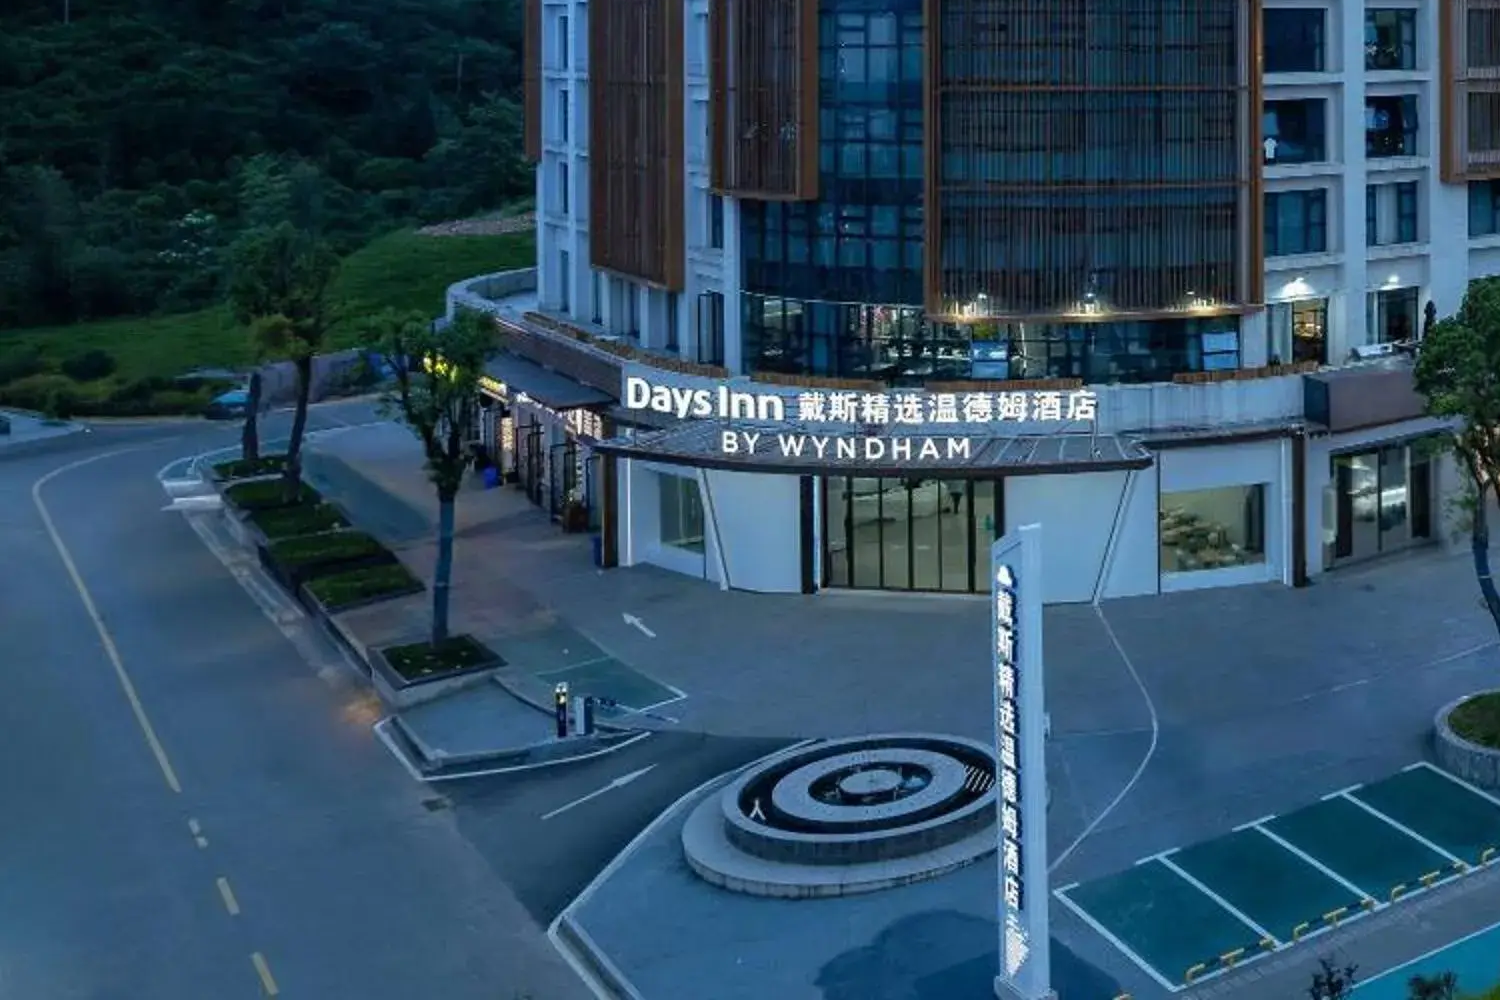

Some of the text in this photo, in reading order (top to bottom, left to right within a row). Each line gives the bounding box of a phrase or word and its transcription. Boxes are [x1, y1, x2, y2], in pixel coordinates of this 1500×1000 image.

[799, 391, 1097, 424] 戴斯精选温德姆酒店
[722, 431, 971, 461] BY WYNDHAM
